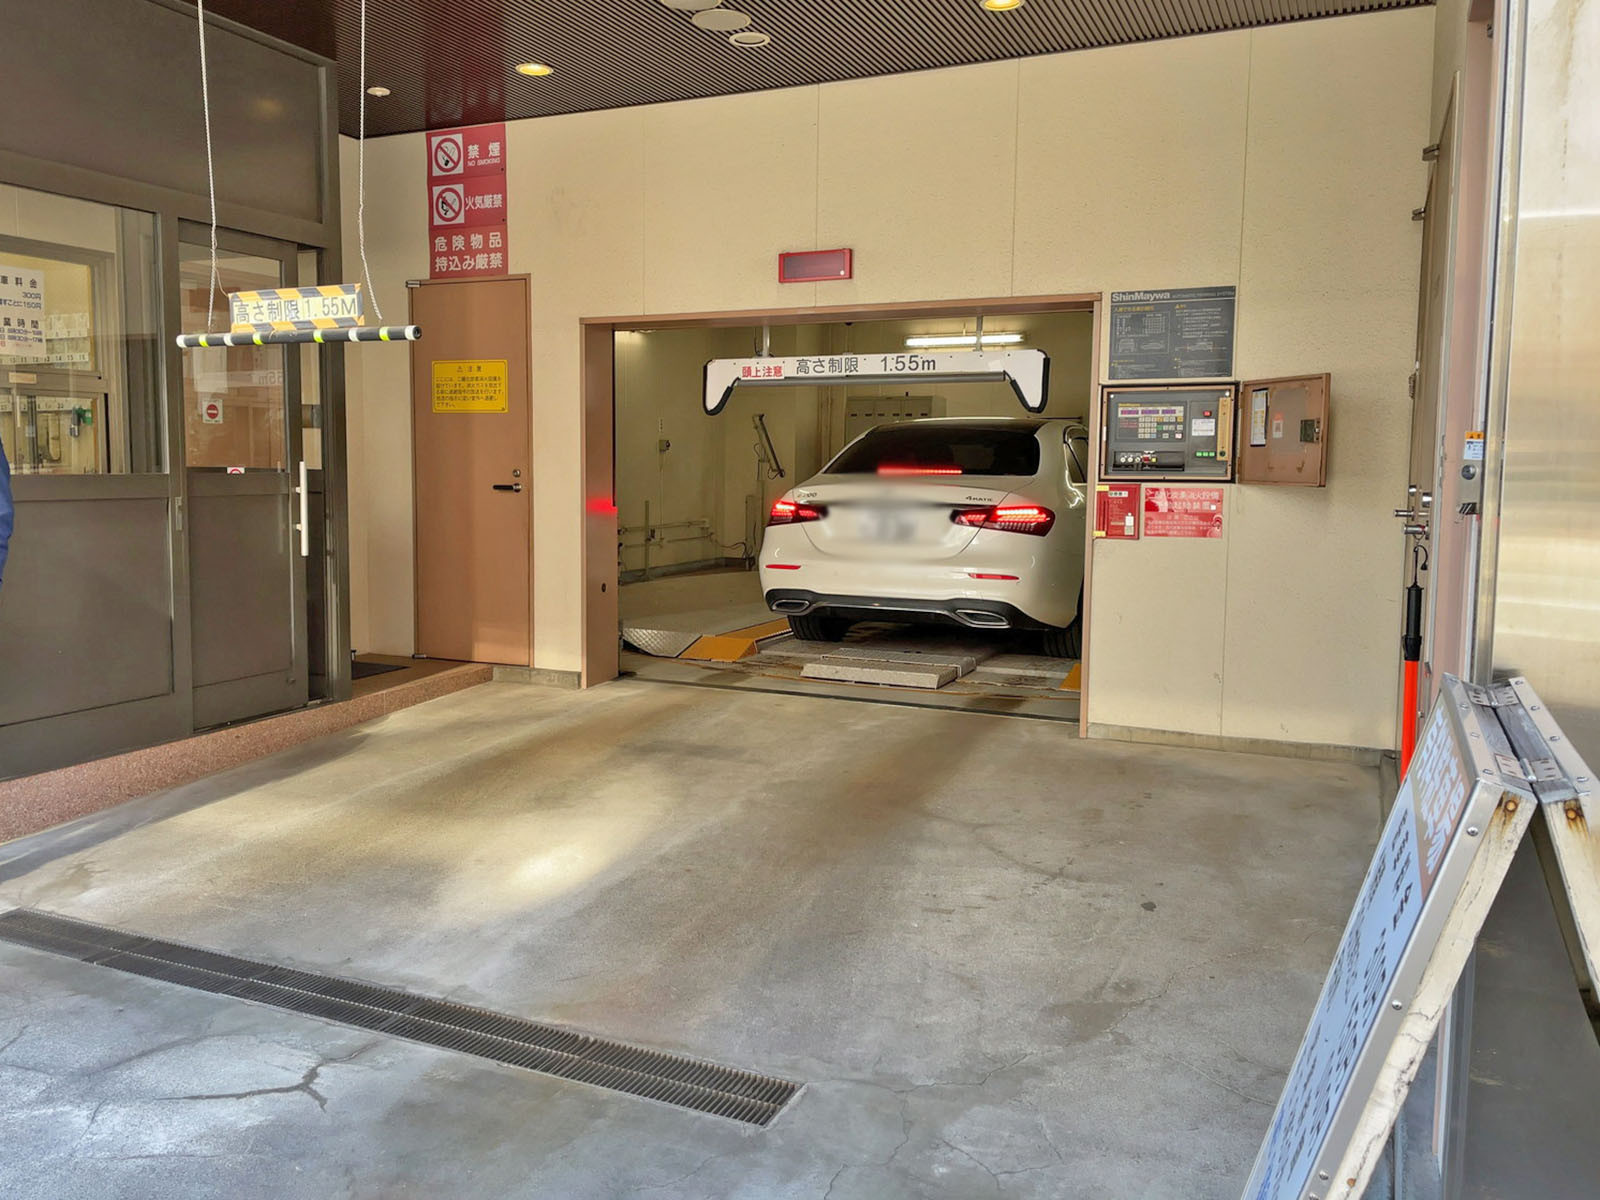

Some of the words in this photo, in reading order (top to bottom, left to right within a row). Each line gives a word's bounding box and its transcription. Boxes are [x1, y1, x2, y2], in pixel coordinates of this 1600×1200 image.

[467, 142, 501, 159] 禁煙
[477, 158, 501, 166] SMOKING
[465, 194, 502, 210] 火気厳禁
[434, 232, 502, 252] 危険物品
[435, 252, 503, 272] 持込み厳禁
[1111, 291, 1171, 303] ShinMaywa
[741, 365, 784, 379] 頭上注意
[796, 357, 860, 375] 高さ制限
[880, 354, 937, 373] 1.55m
